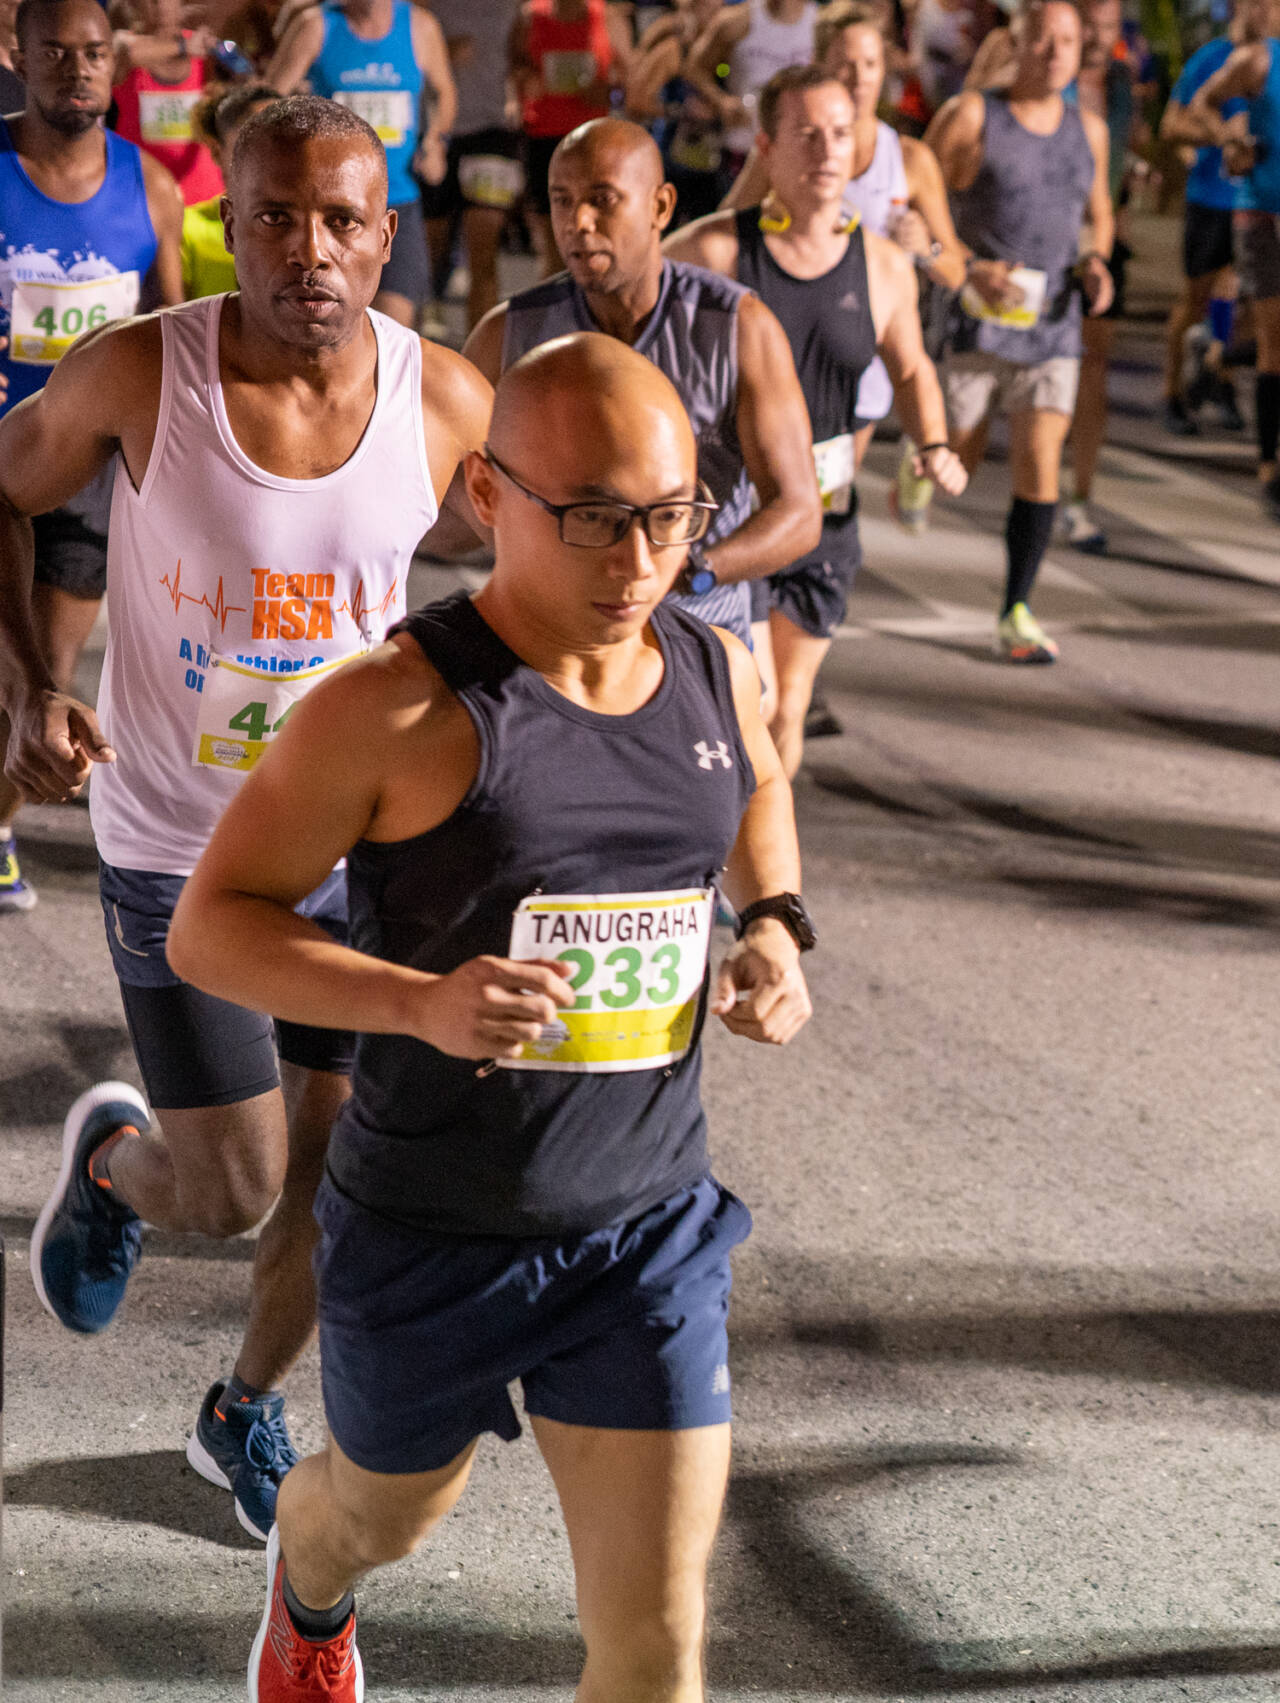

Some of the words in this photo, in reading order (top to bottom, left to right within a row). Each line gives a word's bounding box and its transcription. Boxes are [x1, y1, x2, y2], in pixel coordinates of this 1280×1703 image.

[251, 568, 336, 598] Team
[251, 599, 334, 641] HSA
[178, 637, 193, 663] A
[531, 906, 699, 945] TANUGRAHA
[555, 943, 682, 1010] 233
